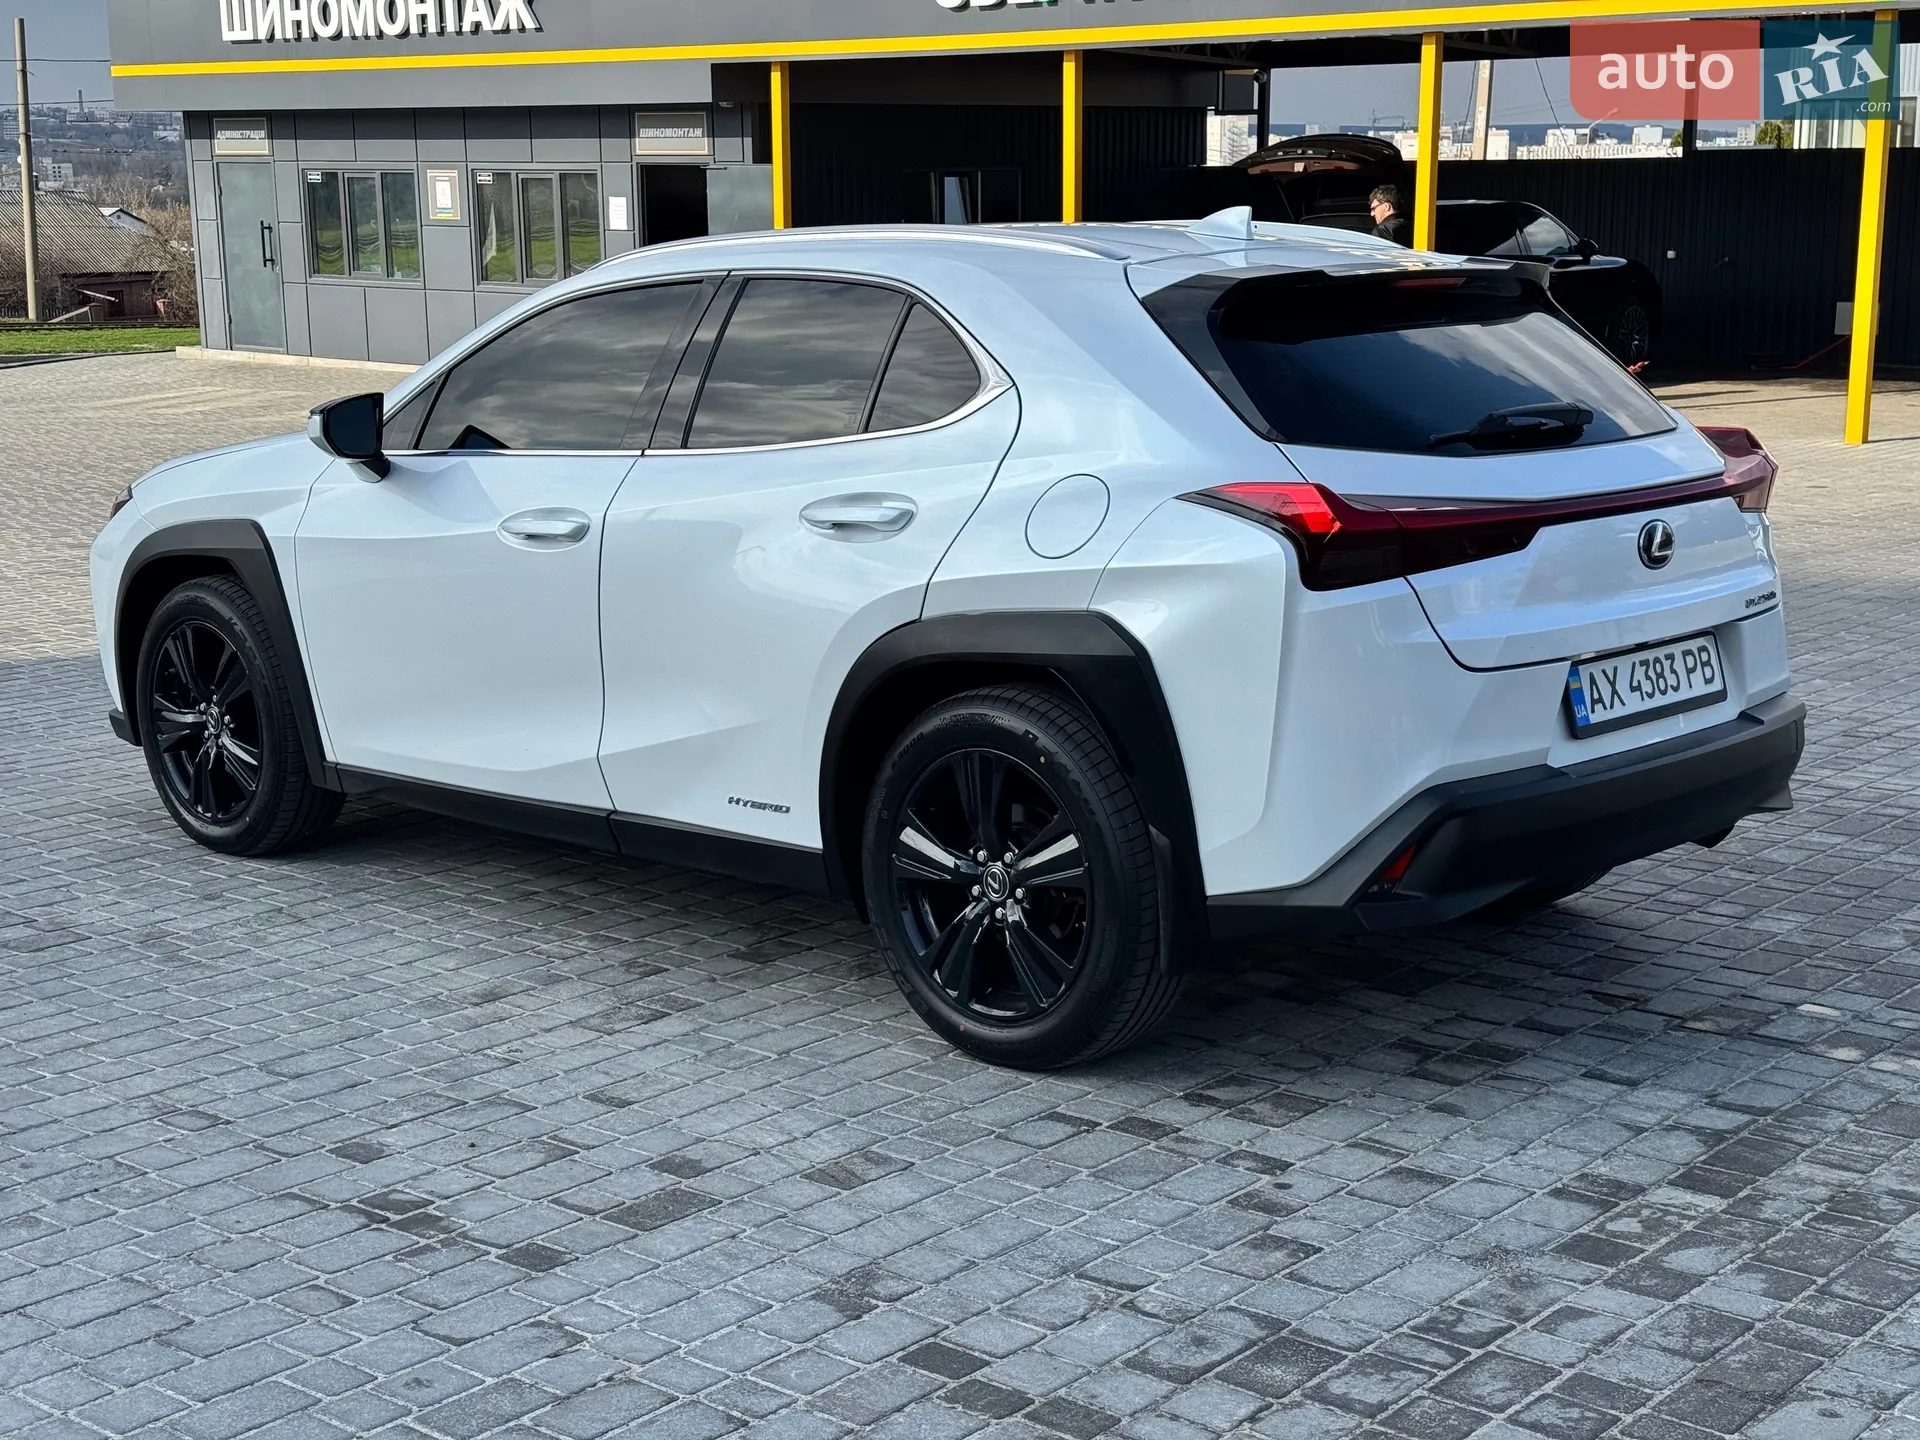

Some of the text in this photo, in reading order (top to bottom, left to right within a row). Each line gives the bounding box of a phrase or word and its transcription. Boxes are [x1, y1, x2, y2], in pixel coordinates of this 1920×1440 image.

[639, 127, 703, 138] ШИНОМОНТАЖ
[1589, 645, 1715, 714] AX 4383 PB
[1574, 705, 1588, 718] UA
[727, 796, 791, 814] HYBRID
